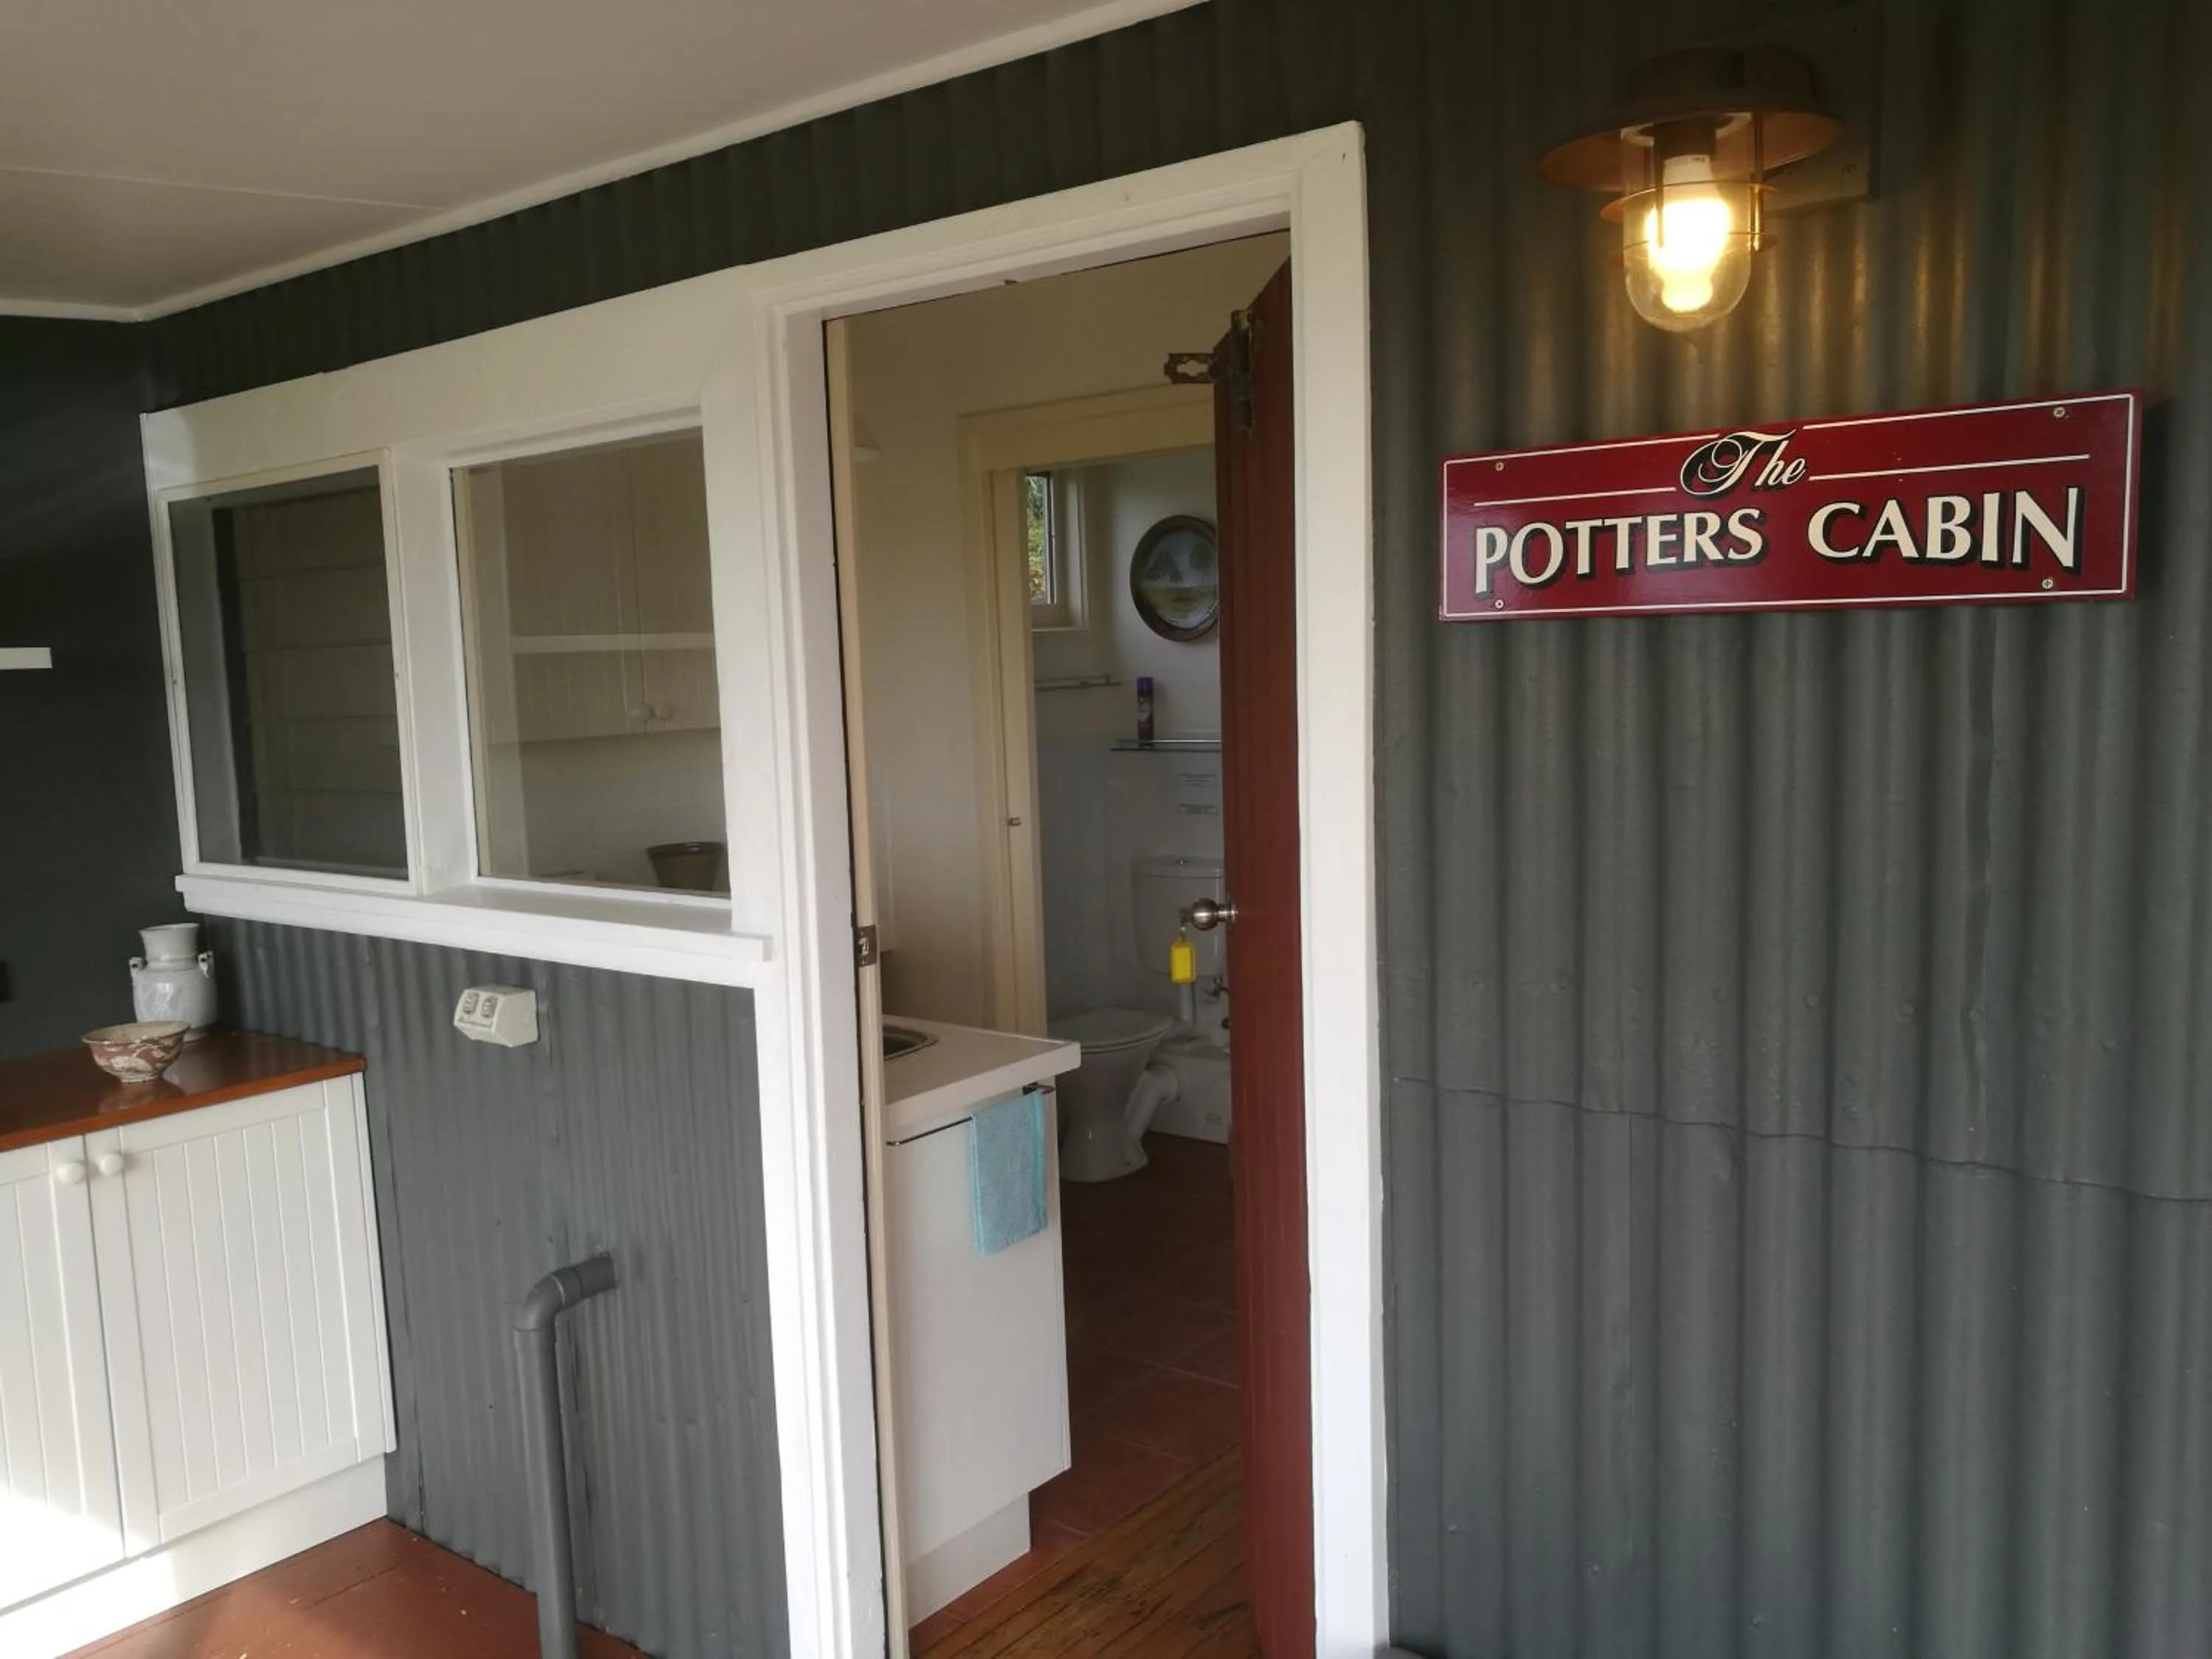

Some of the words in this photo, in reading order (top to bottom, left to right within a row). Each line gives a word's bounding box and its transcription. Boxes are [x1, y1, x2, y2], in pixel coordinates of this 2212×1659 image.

[1680, 429, 1806, 496] The
[1475, 508, 1765, 594] POTTERS
[1807, 487, 2080, 571] CABIN
